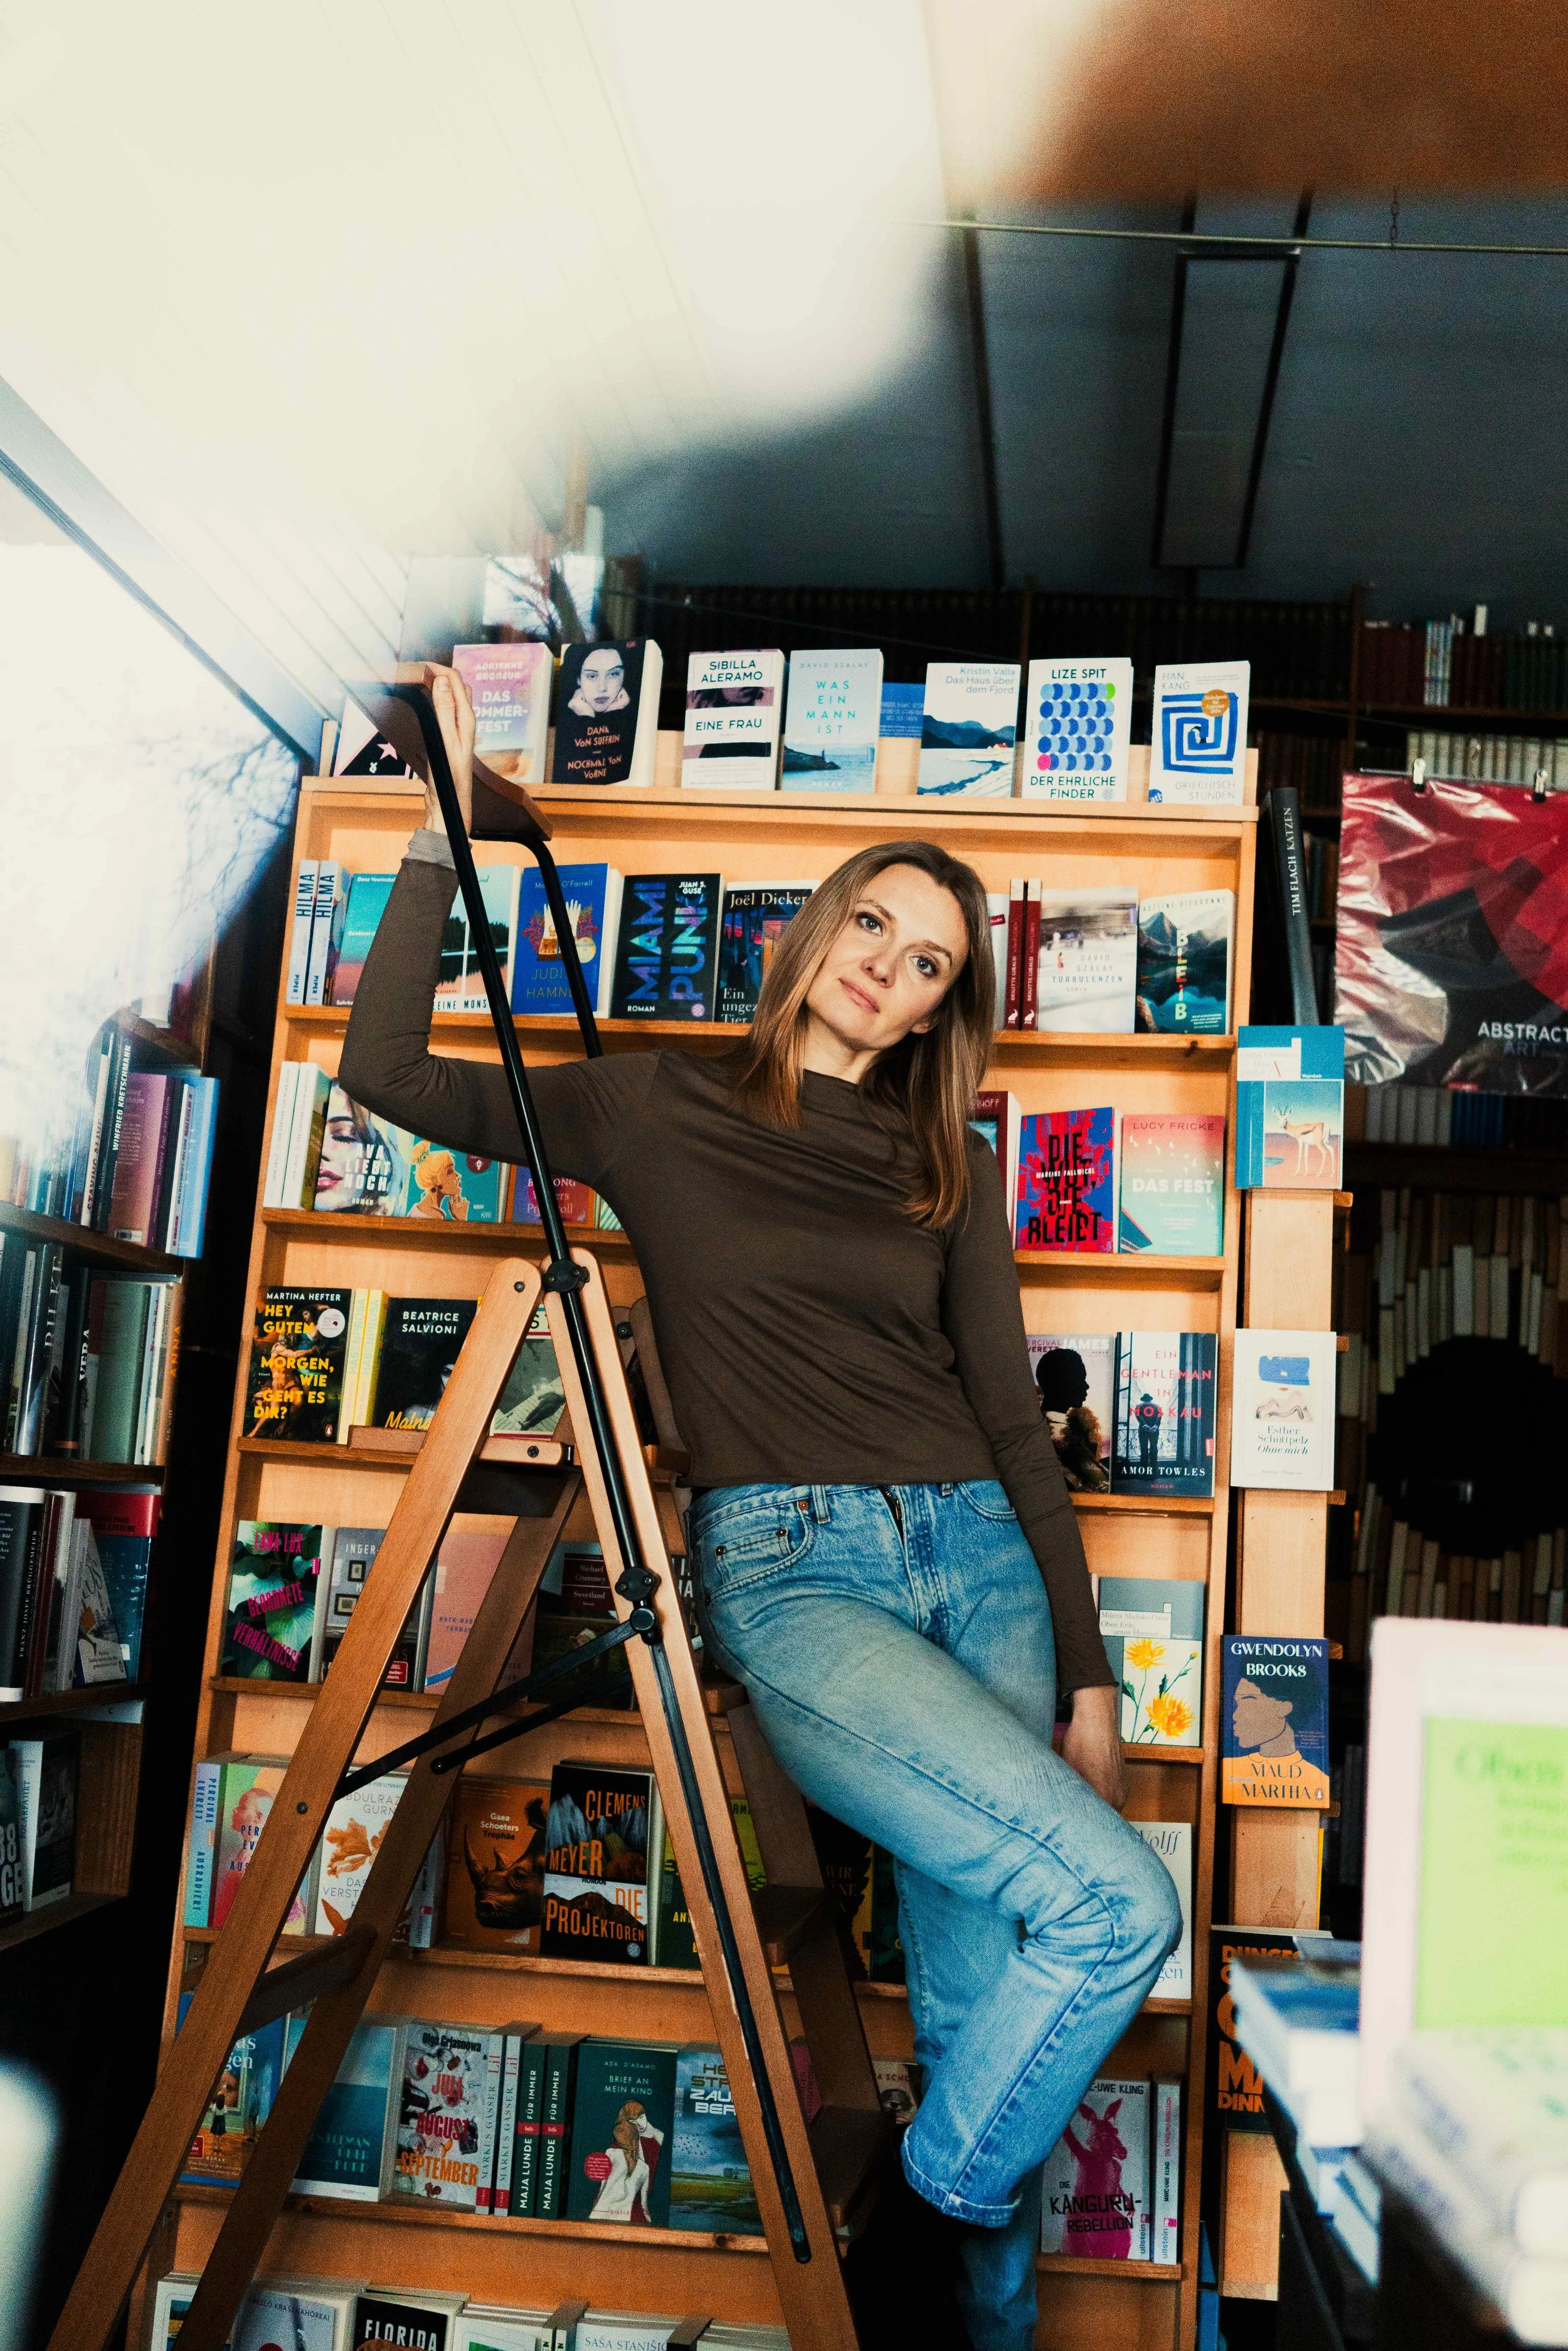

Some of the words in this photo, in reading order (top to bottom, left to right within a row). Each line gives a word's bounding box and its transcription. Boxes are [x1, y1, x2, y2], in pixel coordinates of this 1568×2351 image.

[475, 662, 523, 671] ADRIENNE
[709, 659, 756, 670] SIBILLA
[960, 667, 990, 675] Kristin
[476, 672, 520, 680] BRODEUR
[701, 671, 763, 683] ALERAMO
[1052, 669, 1077, 679] LIZE
[1082, 669, 1106, 678] SPIT
[1162, 672, 1184, 680] HAN
[816, 681, 850, 690] WAS
[990, 686, 1014, 694] Fjord
[1162, 681, 1190, 690] KANG
[482, 690, 510, 703] DAS
[818, 696, 847, 704] EIN
[474, 704, 529, 718] OMMER-
[806, 710, 856, 719] MANN
[478, 720, 511, 733] FEST
[586, 726, 609, 736] DANA
[696, 720, 723, 731] EINE
[729, 719, 762, 729] FRAU
[817, 725, 843, 733] IST
[593, 735, 620, 745] SUFFRIN
[568, 759, 605, 769] NOCHMAL
[1030, 776, 1053, 785] DER
[1059, 776, 1116, 786] EHRLICHE
[1175, 781, 1235, 790] GRIECHISCH
[1050, 788, 1094, 799] FINDER
[1188, 791, 1234, 800] STUNDEN
[1283, 807, 1296, 851] KATZEN
[1288, 856, 1298, 895] FLACH
[296, 874, 315, 917] HILMA
[315, 875, 335, 918] HILMA
[729, 893, 755, 909] Joël
[761, 893, 807, 906] Dicker
[1292, 898, 1301, 915] TIM
[627, 883, 666, 1000] MIAMI
[669, 893, 708, 1000] PUNK
[723, 988, 744, 1000] Ein
[1478, 1021, 1568, 1043] ABSTRACT
[117, 1045, 132, 1108] KRETSCHMANN
[112, 1109, 124, 1150] WINFRIED
[1170, 1122, 1214, 1130] FRICKE
[356, 1144, 384, 1159] AVA
[1048, 1132, 1083, 1162] DIE
[345, 1160, 391, 1176] LIEBT
[1036, 1170, 1061, 1179] MAREIKE
[344, 1175, 388, 1191] NOCH
[1132, 1179, 1169, 1192] DAS
[1173, 1179, 1213, 1194] FEST
[1047, 1187, 1083, 1215] DIE
[1027, 1212, 1102, 1244] BLEIBT
[267, 1292, 305, 1300] MARTINA
[265, 1305, 294, 1317] HEY
[403, 1311, 459, 1322] BEATRICE
[263, 1321, 315, 1334] GUTEN
[402, 1324, 457, 1335] SALVIONI
[1061, 1339, 1110, 1349] JAMES
[79, 1328, 90, 1381] VERA
[170, 1325, 181, 1379] ANNA
[1155, 1351, 1177, 1359] EIN
[261, 1356, 334, 1372] MORGEN,
[300, 1375, 327, 1388] WIE
[1121, 1369, 1212, 1380] GENTLEMAN
[262, 1390, 302, 1403] GEHT
[308, 1391, 325, 1404] ES
[253, 1406, 287, 1419] DIR?
[1129, 1407, 1202, 1418] MOSKAU
[1268, 1426, 1300, 1435] Esther
[1258, 1445, 1283, 1454] Ohne
[1285, 1446, 1308, 1455] mich
[1121, 1467, 1152, 1475] AMOR
[1159, 1467, 1205, 1477] TOWLES
[254, 1531, 280, 1552] LANA
[283, 1532, 303, 1554] LUX
[26, 1530, 38, 1595] BRÜGGEMEIER
[580, 1564, 603, 1573] Michael
[575, 1574, 605, 1583] Crummey
[246, 1581, 304, 1618] GEORDNETE
[573, 1590, 605, 1599] Sweetland
[233, 1621, 302, 1671] VERHÄLTNISSE
[1231, 1642, 1322, 1657] GWENDOLYN
[1246, 1663, 1307, 1677] BROOKS
[1251, 1763, 1302, 1778] MAUD
[1242, 1784, 1311, 1799] MARTHA
[195, 1780, 205, 1820] EVERETT
[205, 1778, 216, 1823] PERCIVAL
[586, 1790, 645, 1822] CLEMENS
[490, 1813, 510, 1822] Gaea
[480, 1821, 519, 1832] Schoeters
[484, 1831, 516, 1840] Trophäe
[549, 1839, 603, 1878] MEYER
[193, 1851, 204, 1911] AUSRADIERT
[615, 1887, 644, 1921] DIE
[545, 1898, 645, 1942] PROJEKTOREN
[422, 2032, 439, 2045] Olga
[440, 2035, 481, 2052] Grjasnowa
[623, 2061, 656, 2069] D'ADAMO
[527, 2069, 537, 2100] IMMER
[551, 2070, 560, 2101] IMMER
[609, 2075, 632, 2084] BRIEF
[604, 2086, 627, 2094] MEIN
[631, 2086, 653, 2095] KIND
[1119, 2085, 1144, 2094] KLING
[486, 2085, 495, 2129] GASSER
[525, 2103, 534, 2120] FÜR
[549, 2103, 558, 2121] FÜR
[416, 2112, 472, 2142] AUGUST
[499, 2137, 509, 2182] MARKUS
[504, 2087, 514, 2131] GASSER
[521, 2138, 532, 2175] LUNDE
[545, 2139, 556, 2176] LUNDE
[396, 2150, 479, 2187] SEPTEMBER
[519, 2178, 529, 2209] MAJA
[543, 2179, 553, 2210] MAJA
[1067, 2217, 1134, 2233] REBELLION
[364, 2318, 438, 2351] FLORIDA
[585, 2337, 612, 2348] SAŠA
